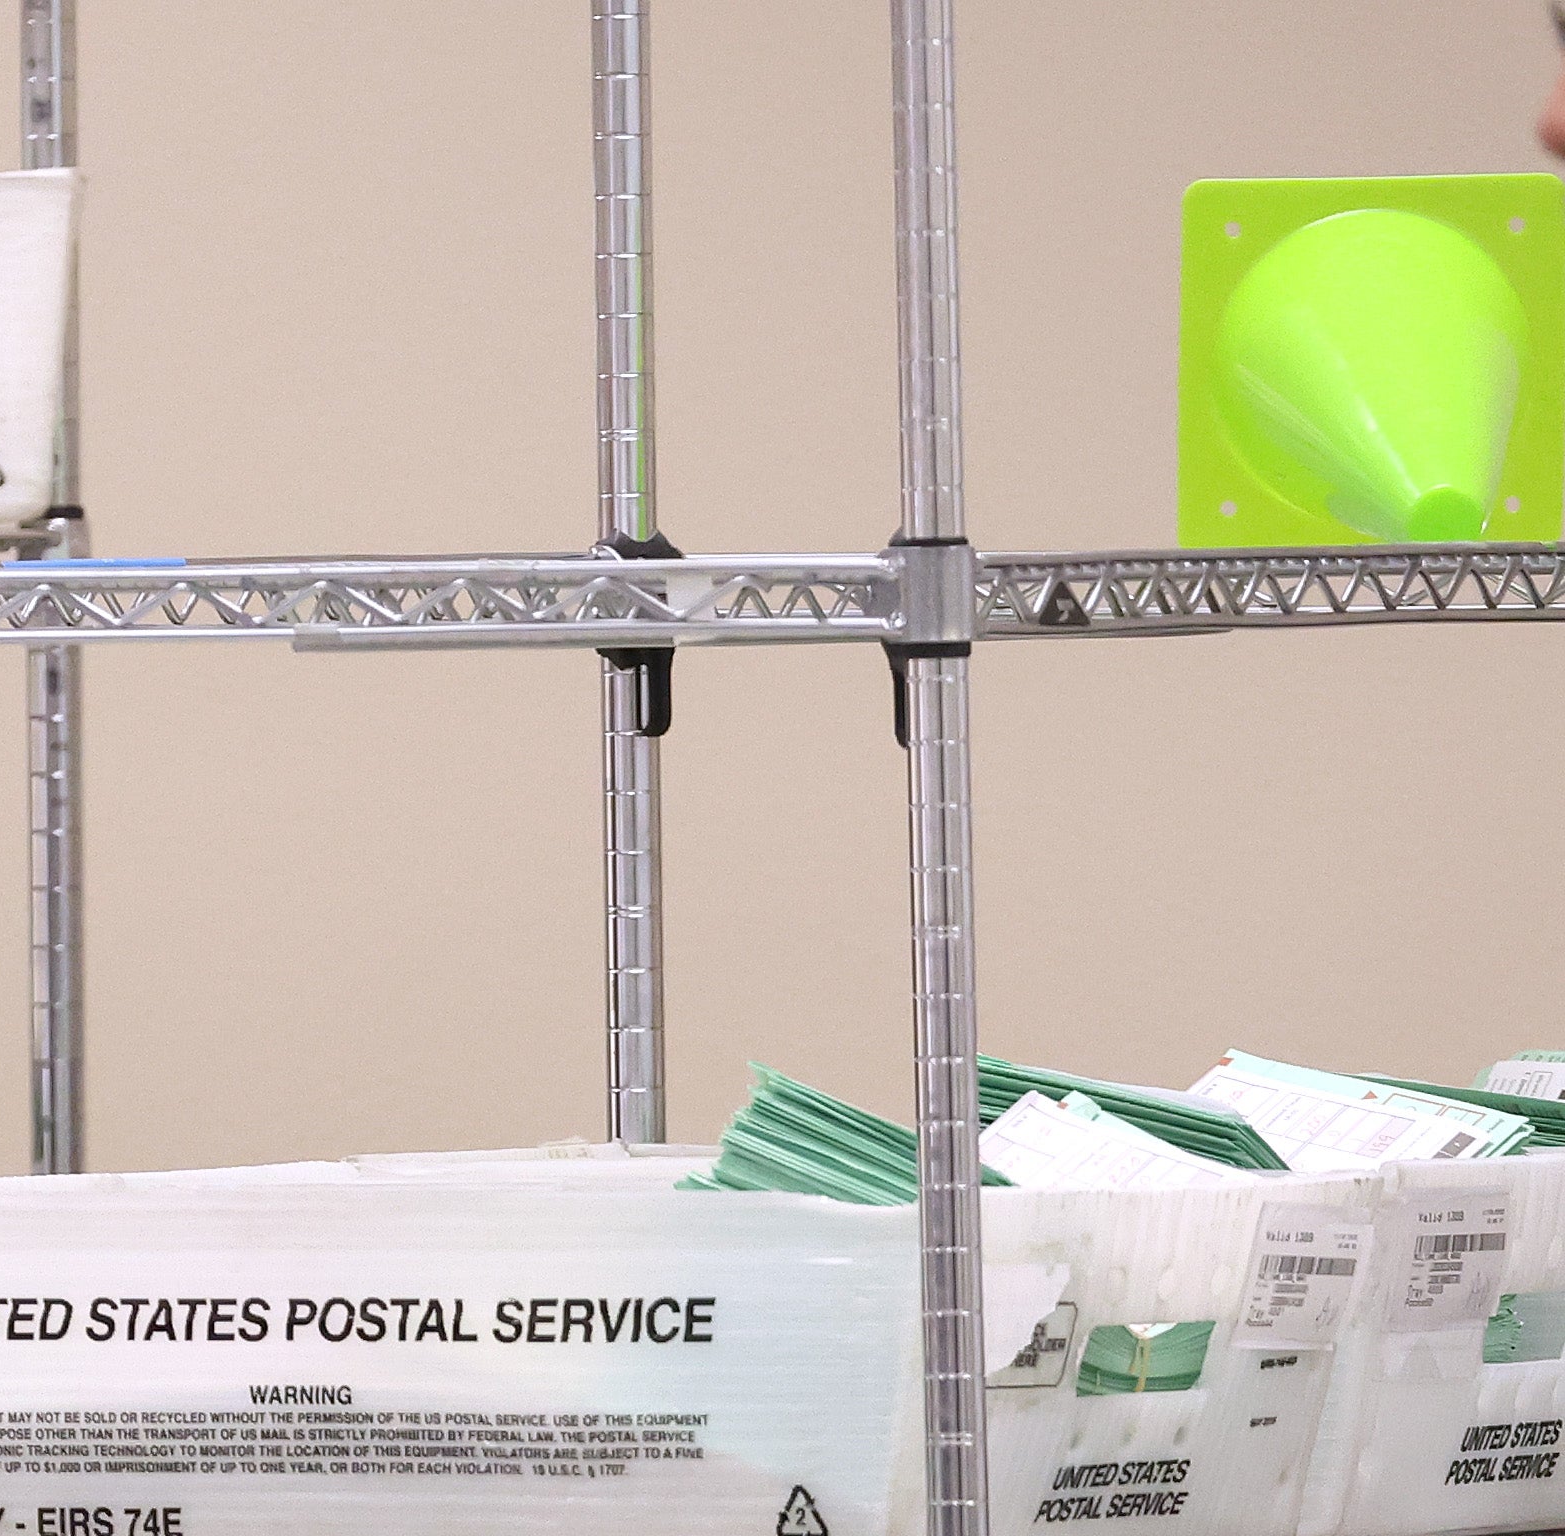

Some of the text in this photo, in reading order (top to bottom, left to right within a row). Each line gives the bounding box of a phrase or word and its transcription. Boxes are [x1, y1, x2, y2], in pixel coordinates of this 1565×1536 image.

[87, 1296, 269, 1343] STATES
[286, 1295, 476, 1343] POSTAL
[494, 1295, 715, 1343] SERVICE
[250, 1384, 352, 1405] WARNING
[7, 1410, 33, 1425] MAY
[36, 1410, 61, 1425] NOT
[64, 1410, 81, 1425] BE
[84, 1410, 117, 1425] SOLD
[120, 1410, 138, 1425] OR
[141, 1410, 208, 1426] RECYCLED
[210, 1411, 266, 1426] WITHOUT
[271, 1411, 294, 1426] THE
[297, 1411, 374, 1426] PERMISSION
[377, 1411, 394, 1426] OF
[398, 1411, 422, 1426] THE
[424, 1411, 442, 1427] US
[444, 1412, 493, 1427] POSTAL
[553, 1412, 580, 1427] USE
[582, 1412, 599, 1427] OF
[35, 1427, 77, 1441] OTHER
[80, 1427, 113, 1442] THAN
[117, 1427, 140, 1442] THE
[144, 1427, 216, 1442] TRANSPORT
[220, 1428, 237, 1442] OF
[240, 1428, 257, 1442] US
[260, 1428, 290, 1442] MAIL
[293, 1428, 305, 1442] IS
[308, 1428, 366, 1443] STRICTLY
[370, 1428, 445, 1443] PROHIBITED
[448, 1429, 464, 1443] BY
[468, 1429, 524, 1444] FEDERAL
[561, 1429, 586, 1444] THE
[1461, 1419, 1563, 1452] UNITED STATES
[1052, 1459, 1191, 1490] UNITED STATES
[1445, 1452, 1560, 1486] POSTAL SERVICE
[795, 1507, 807, 1526] 2
[1034, 1492, 1188, 1523] POSTAL SERVICE
